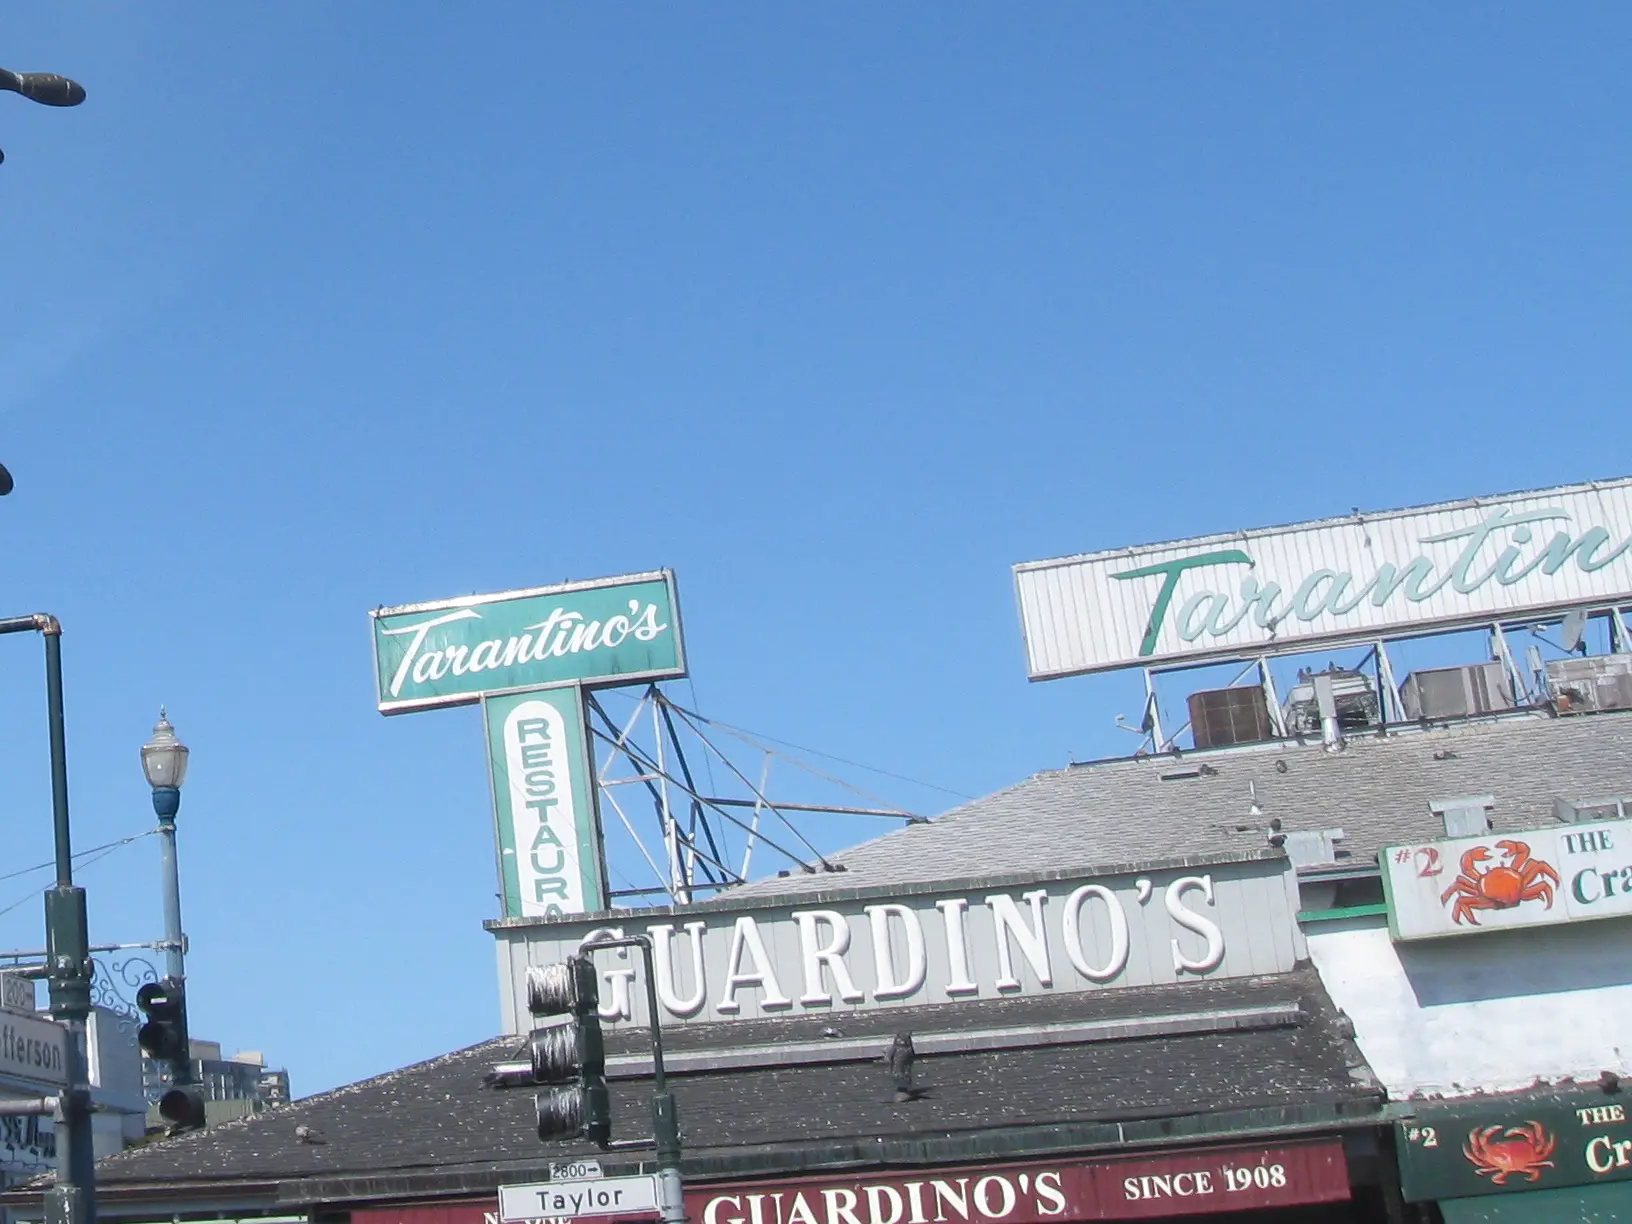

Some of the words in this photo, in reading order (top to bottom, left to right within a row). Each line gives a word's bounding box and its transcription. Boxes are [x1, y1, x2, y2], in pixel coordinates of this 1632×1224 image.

[381, 599, 667, 698] Tarantino's
[1561, 829, 1614, 854] THE
[1395, 847, 1444, 877] #2
[582, 874, 1225, 1020] GUARDINO'S
[1576, 1104, 1625, 1126] THE
[1408, 1126, 1437, 1147] #2
[552, 1164, 586, 1179] 2800
[536, 1188, 623, 1215] Taylor
[702, 1172, 1067, 1224] GUARDINO'S
[1123, 1171, 1214, 1200] SINCE
[1224, 1164, 1287, 1192] 1908
